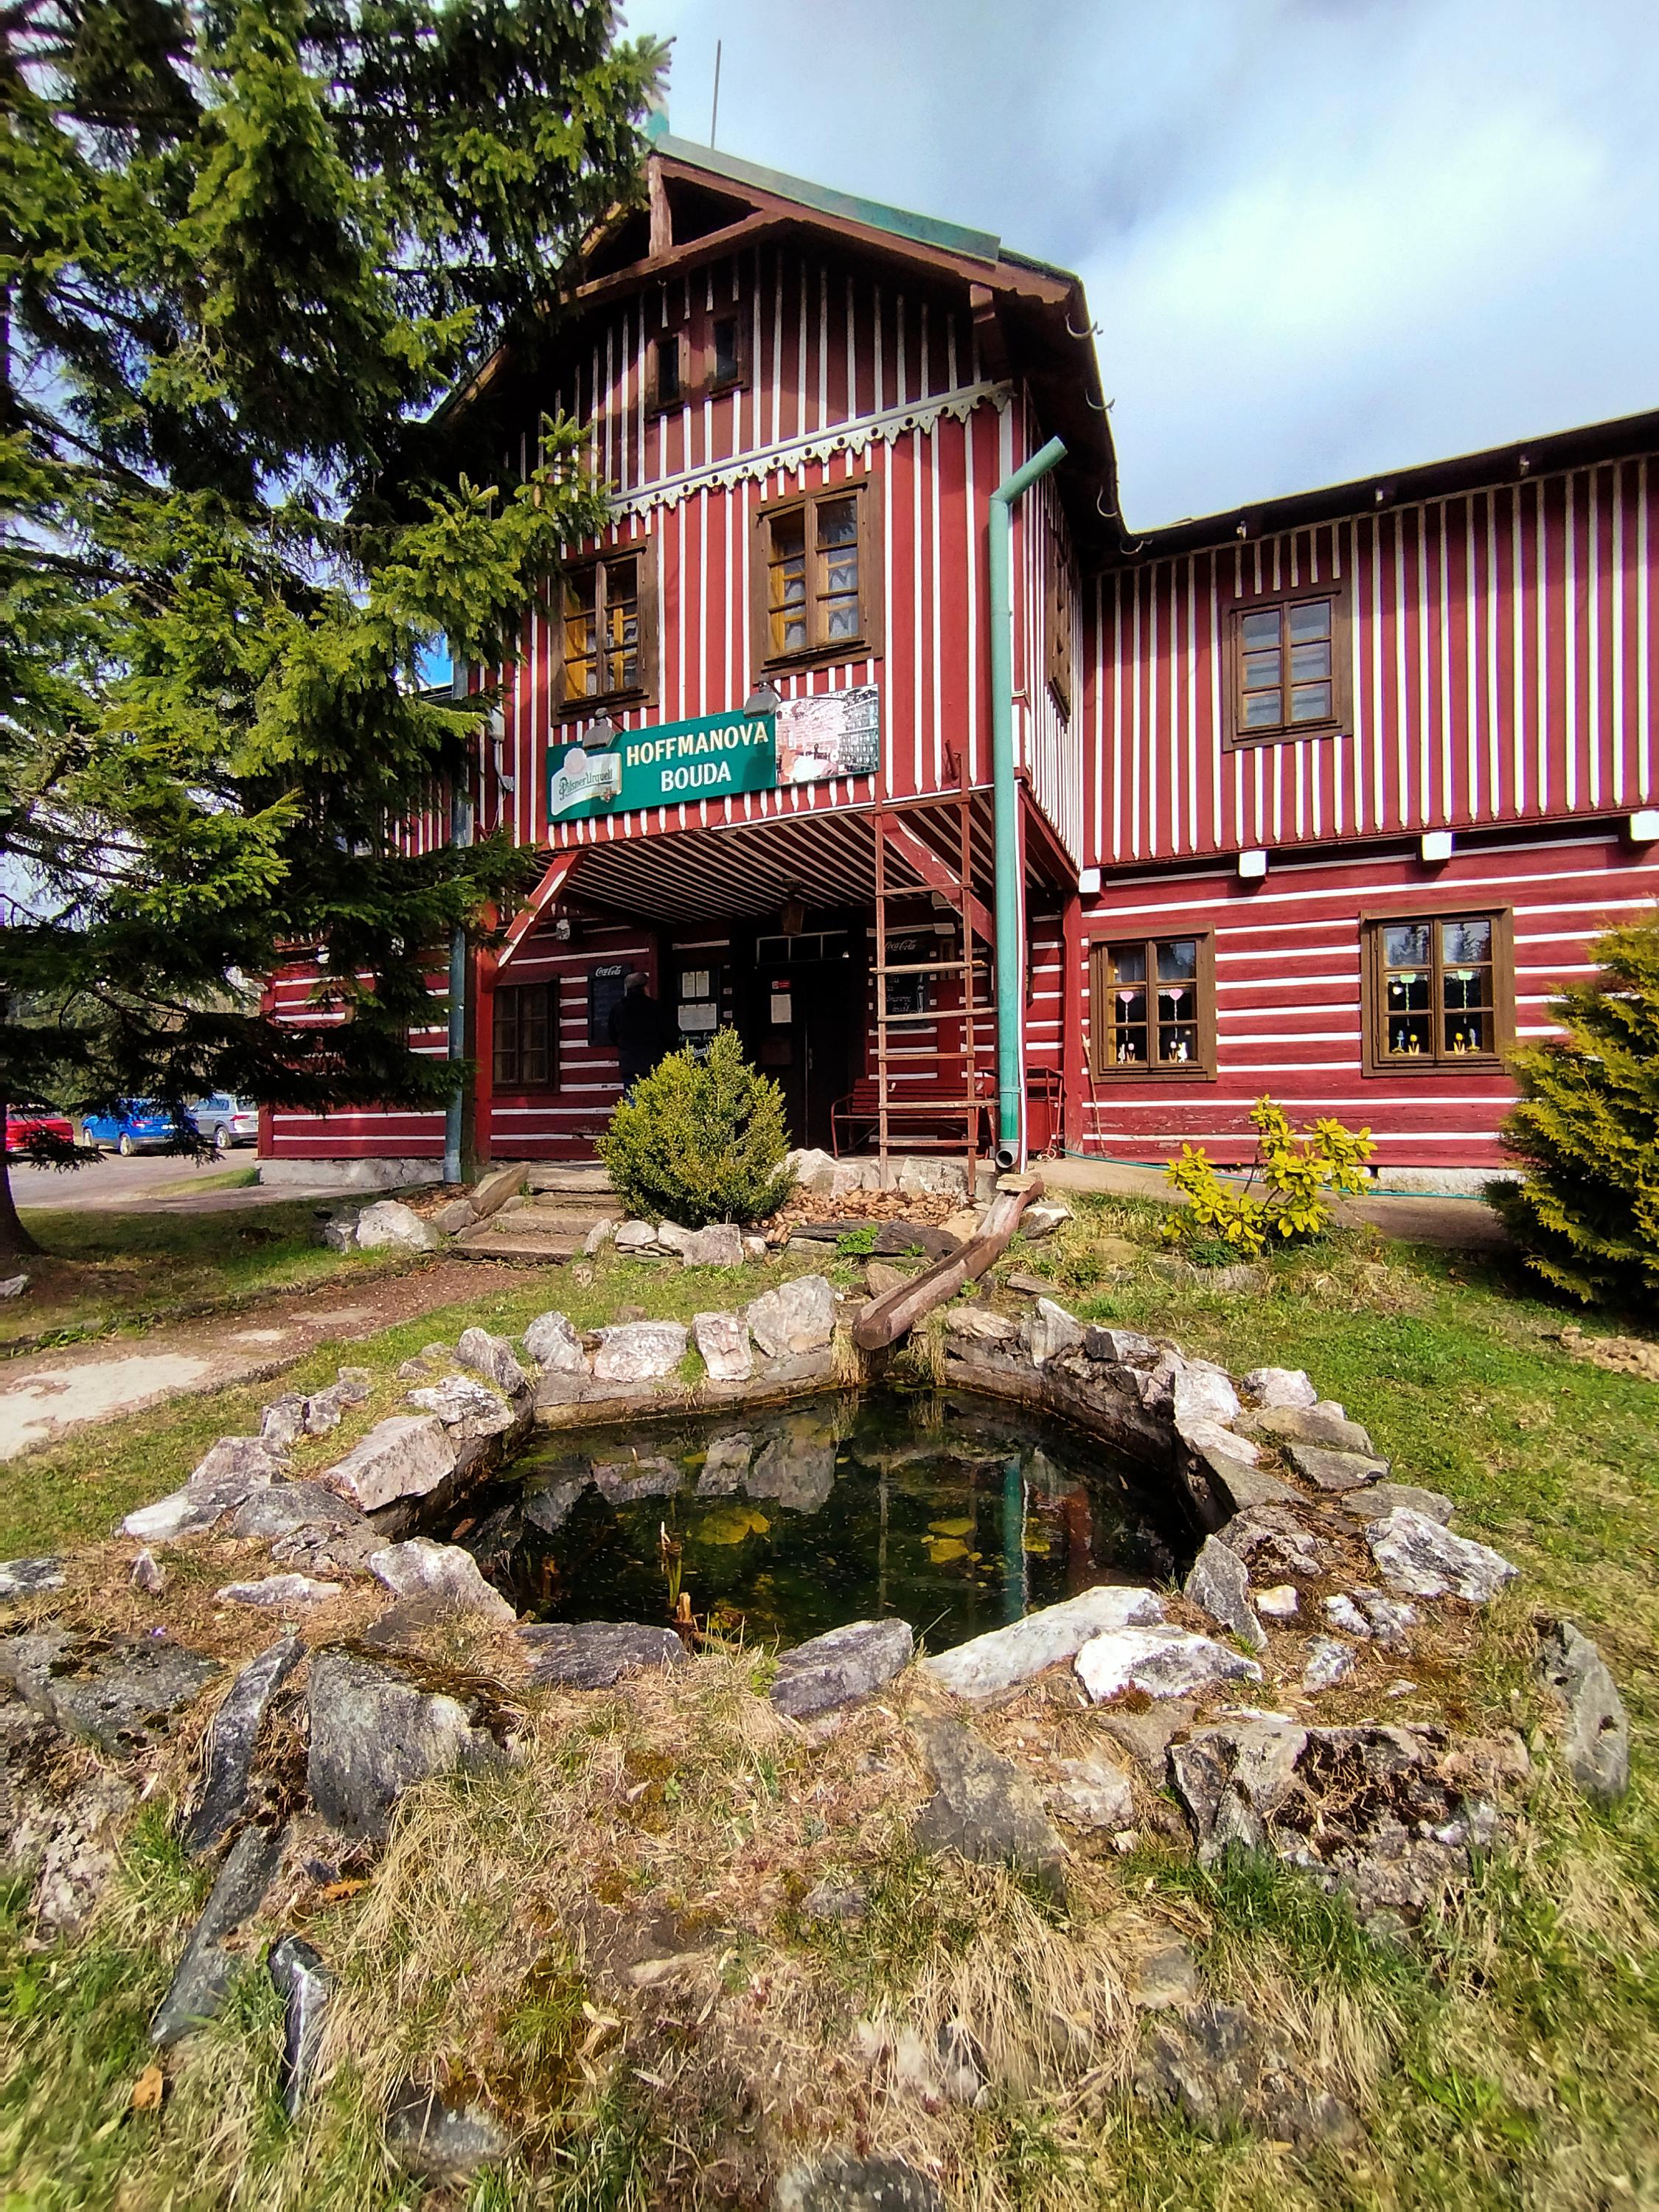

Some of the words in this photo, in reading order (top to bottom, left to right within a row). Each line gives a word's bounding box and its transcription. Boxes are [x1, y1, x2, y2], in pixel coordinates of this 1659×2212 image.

[627, 721, 768, 767] HOFFMANOVA
[558, 776, 586, 801] Pilsner
[585, 768, 613, 784] Urquell
[661, 761, 731, 792] BOUDA
